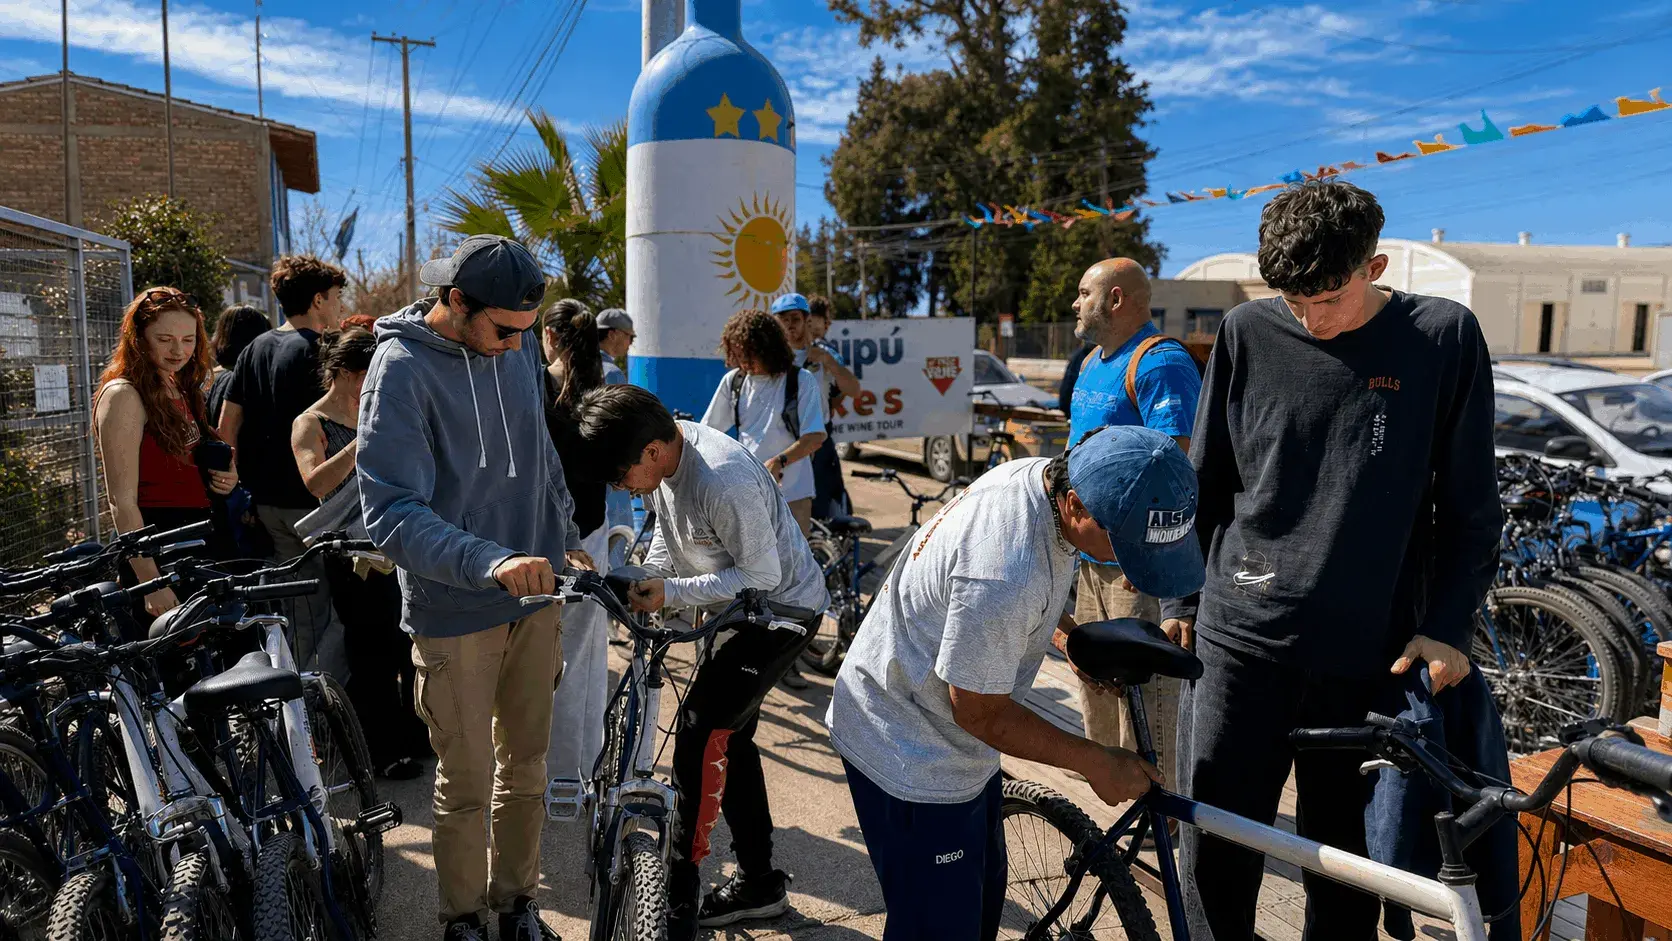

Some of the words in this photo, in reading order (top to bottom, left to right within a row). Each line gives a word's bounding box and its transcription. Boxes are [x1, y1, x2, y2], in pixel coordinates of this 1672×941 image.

[829, 327, 904, 379] ipú
[1368, 376, 1401, 391] BULLS
[832, 424, 844, 434] HE
[847, 421, 873, 432] WINE
[876, 419, 904, 430] TOUR
[935, 849, 964, 864] DIEGO
